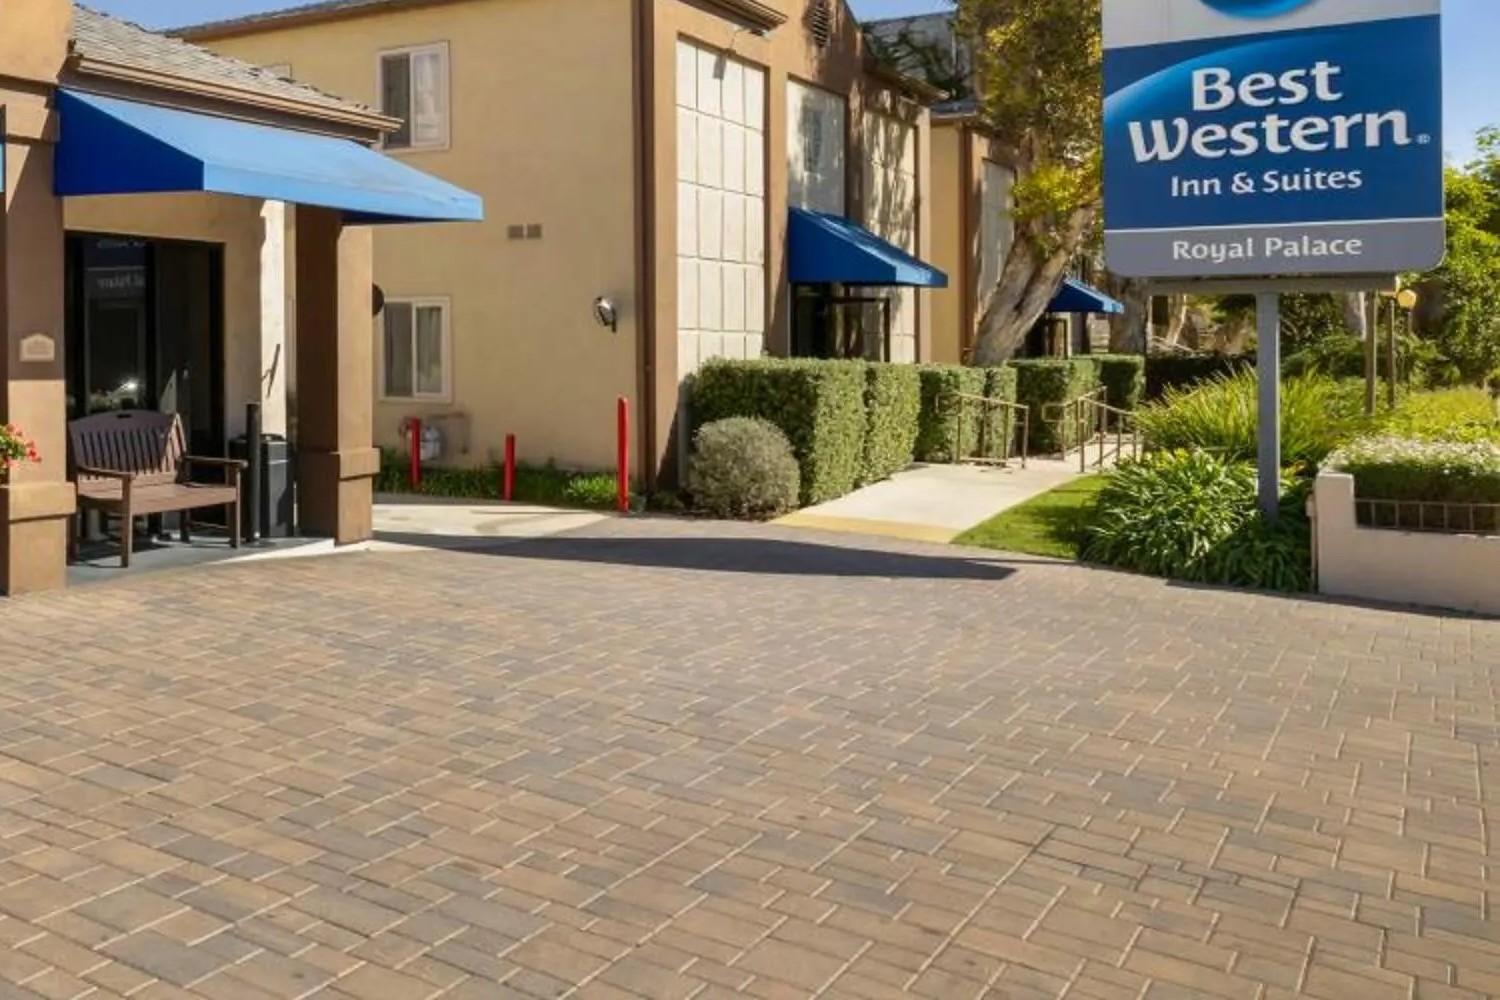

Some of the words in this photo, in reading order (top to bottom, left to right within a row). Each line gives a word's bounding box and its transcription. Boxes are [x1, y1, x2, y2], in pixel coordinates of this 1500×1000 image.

[1191, 60, 1344, 111] Best
[1171, 175, 1222, 197] Inn
[1231, 171, 1255, 195] &
[1263, 168, 1362, 192] Suites
[1172, 238, 1254, 263] Royal
[1265, 236, 1363, 257] Palace
